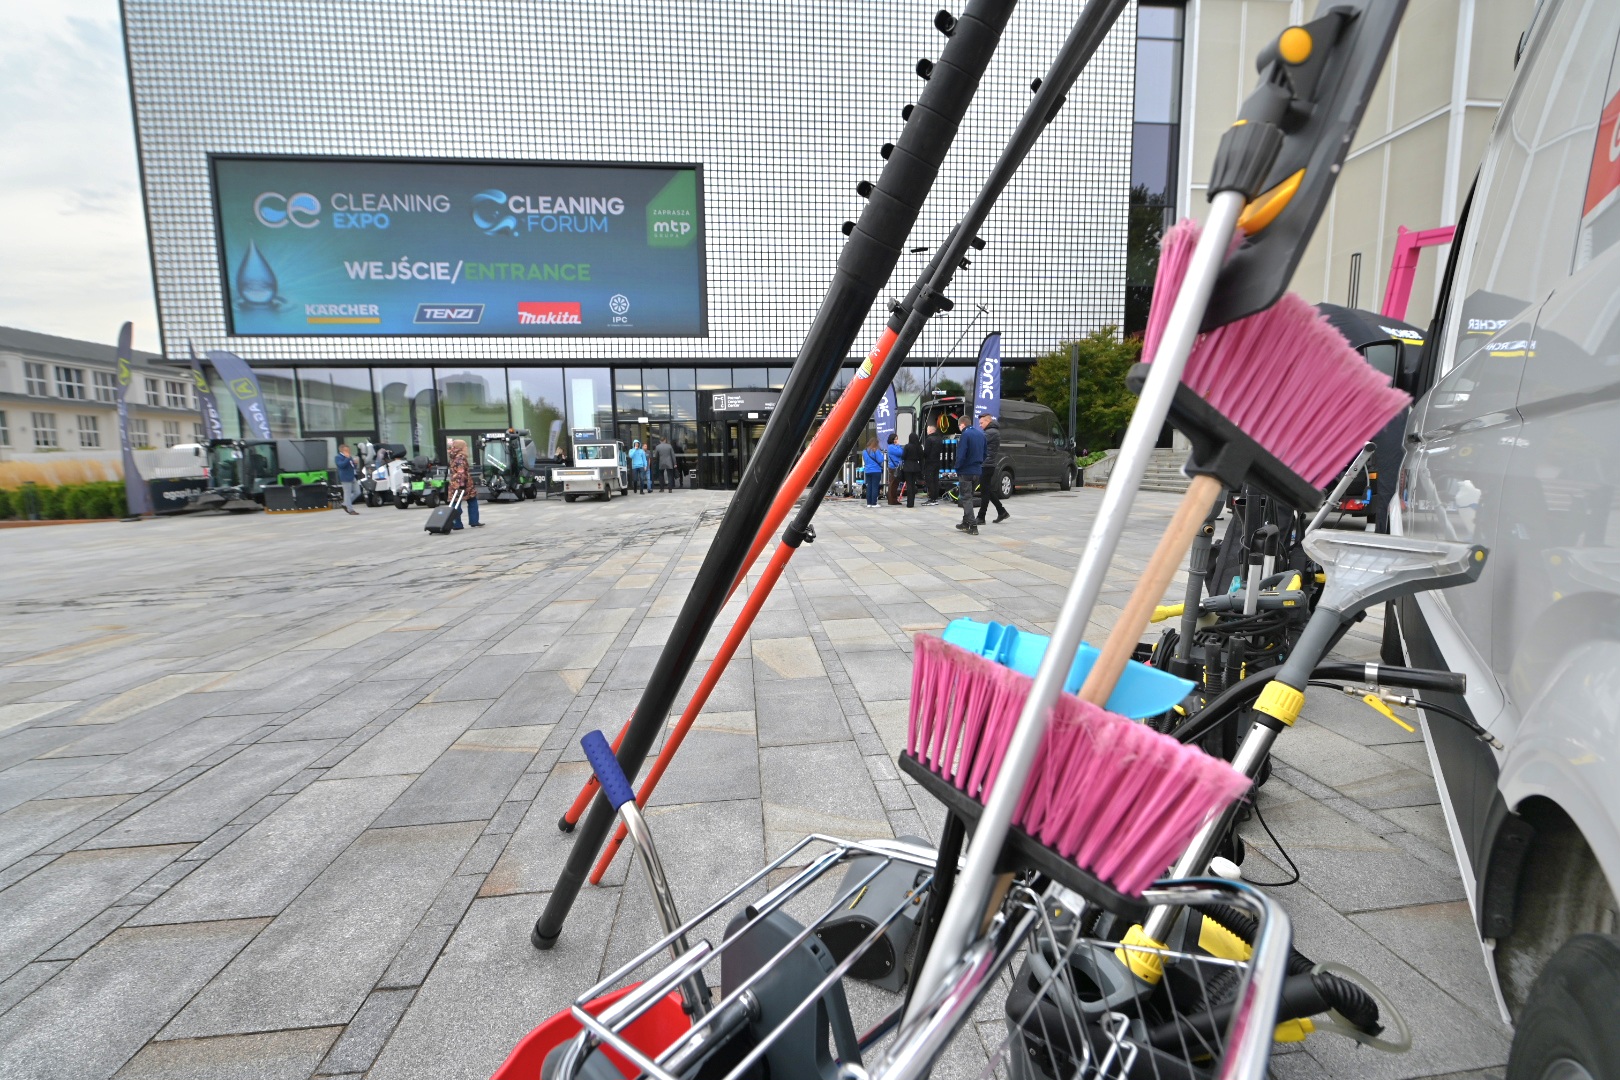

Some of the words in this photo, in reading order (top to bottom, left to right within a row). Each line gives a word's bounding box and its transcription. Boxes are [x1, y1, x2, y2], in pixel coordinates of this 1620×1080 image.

[331, 193, 451, 213] CLEANING
[508, 195, 625, 215] CLEANING
[333, 213, 390, 229] EXPO
[527, 215, 608, 232] FORUM
[653, 220, 690, 235] mtp
[423, 308, 474, 319] TENZI
[982, 357, 998, 400] ionic
